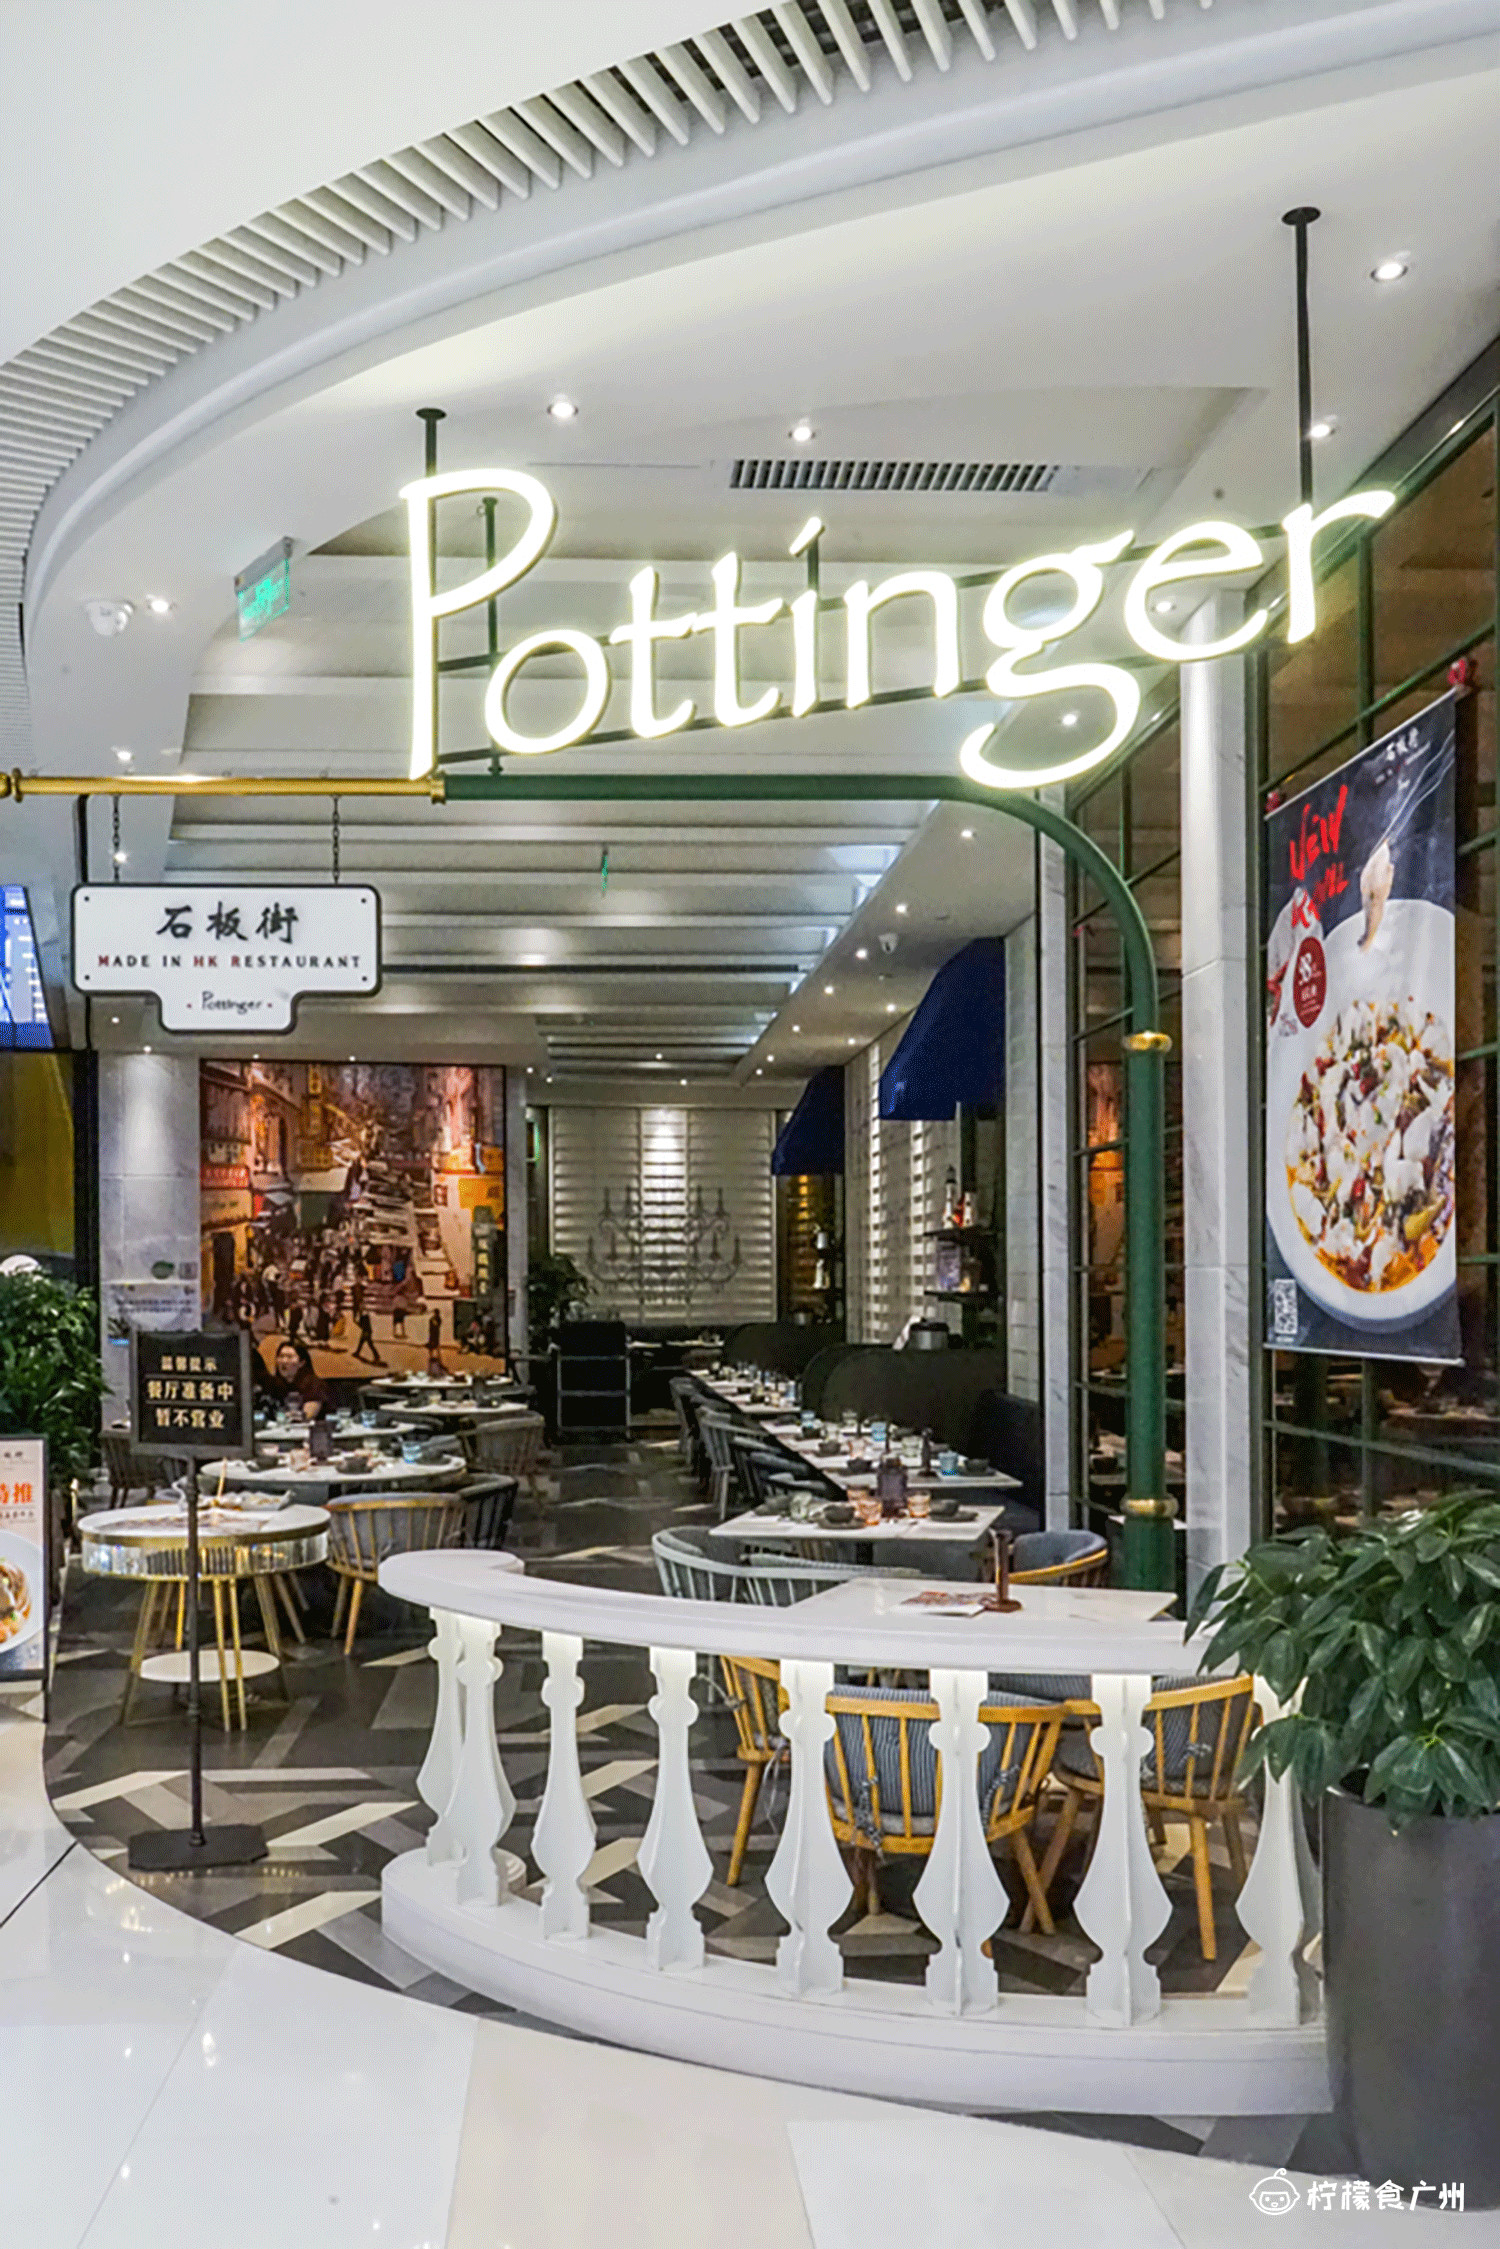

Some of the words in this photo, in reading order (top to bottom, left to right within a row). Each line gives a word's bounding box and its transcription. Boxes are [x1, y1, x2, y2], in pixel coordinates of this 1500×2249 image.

[400, 468, 1396, 790] Pottinger
[156, 900, 299, 944] 石板街
[98, 954, 150, 968] MADE
[162, 954, 182, 968] IN
[193, 954, 218, 968] HK
[231, 954, 361, 968] RESTAURANT
[201, 990, 263, 1015] Pottinger
[156, 1407, 225, 1429] 暂不营业
